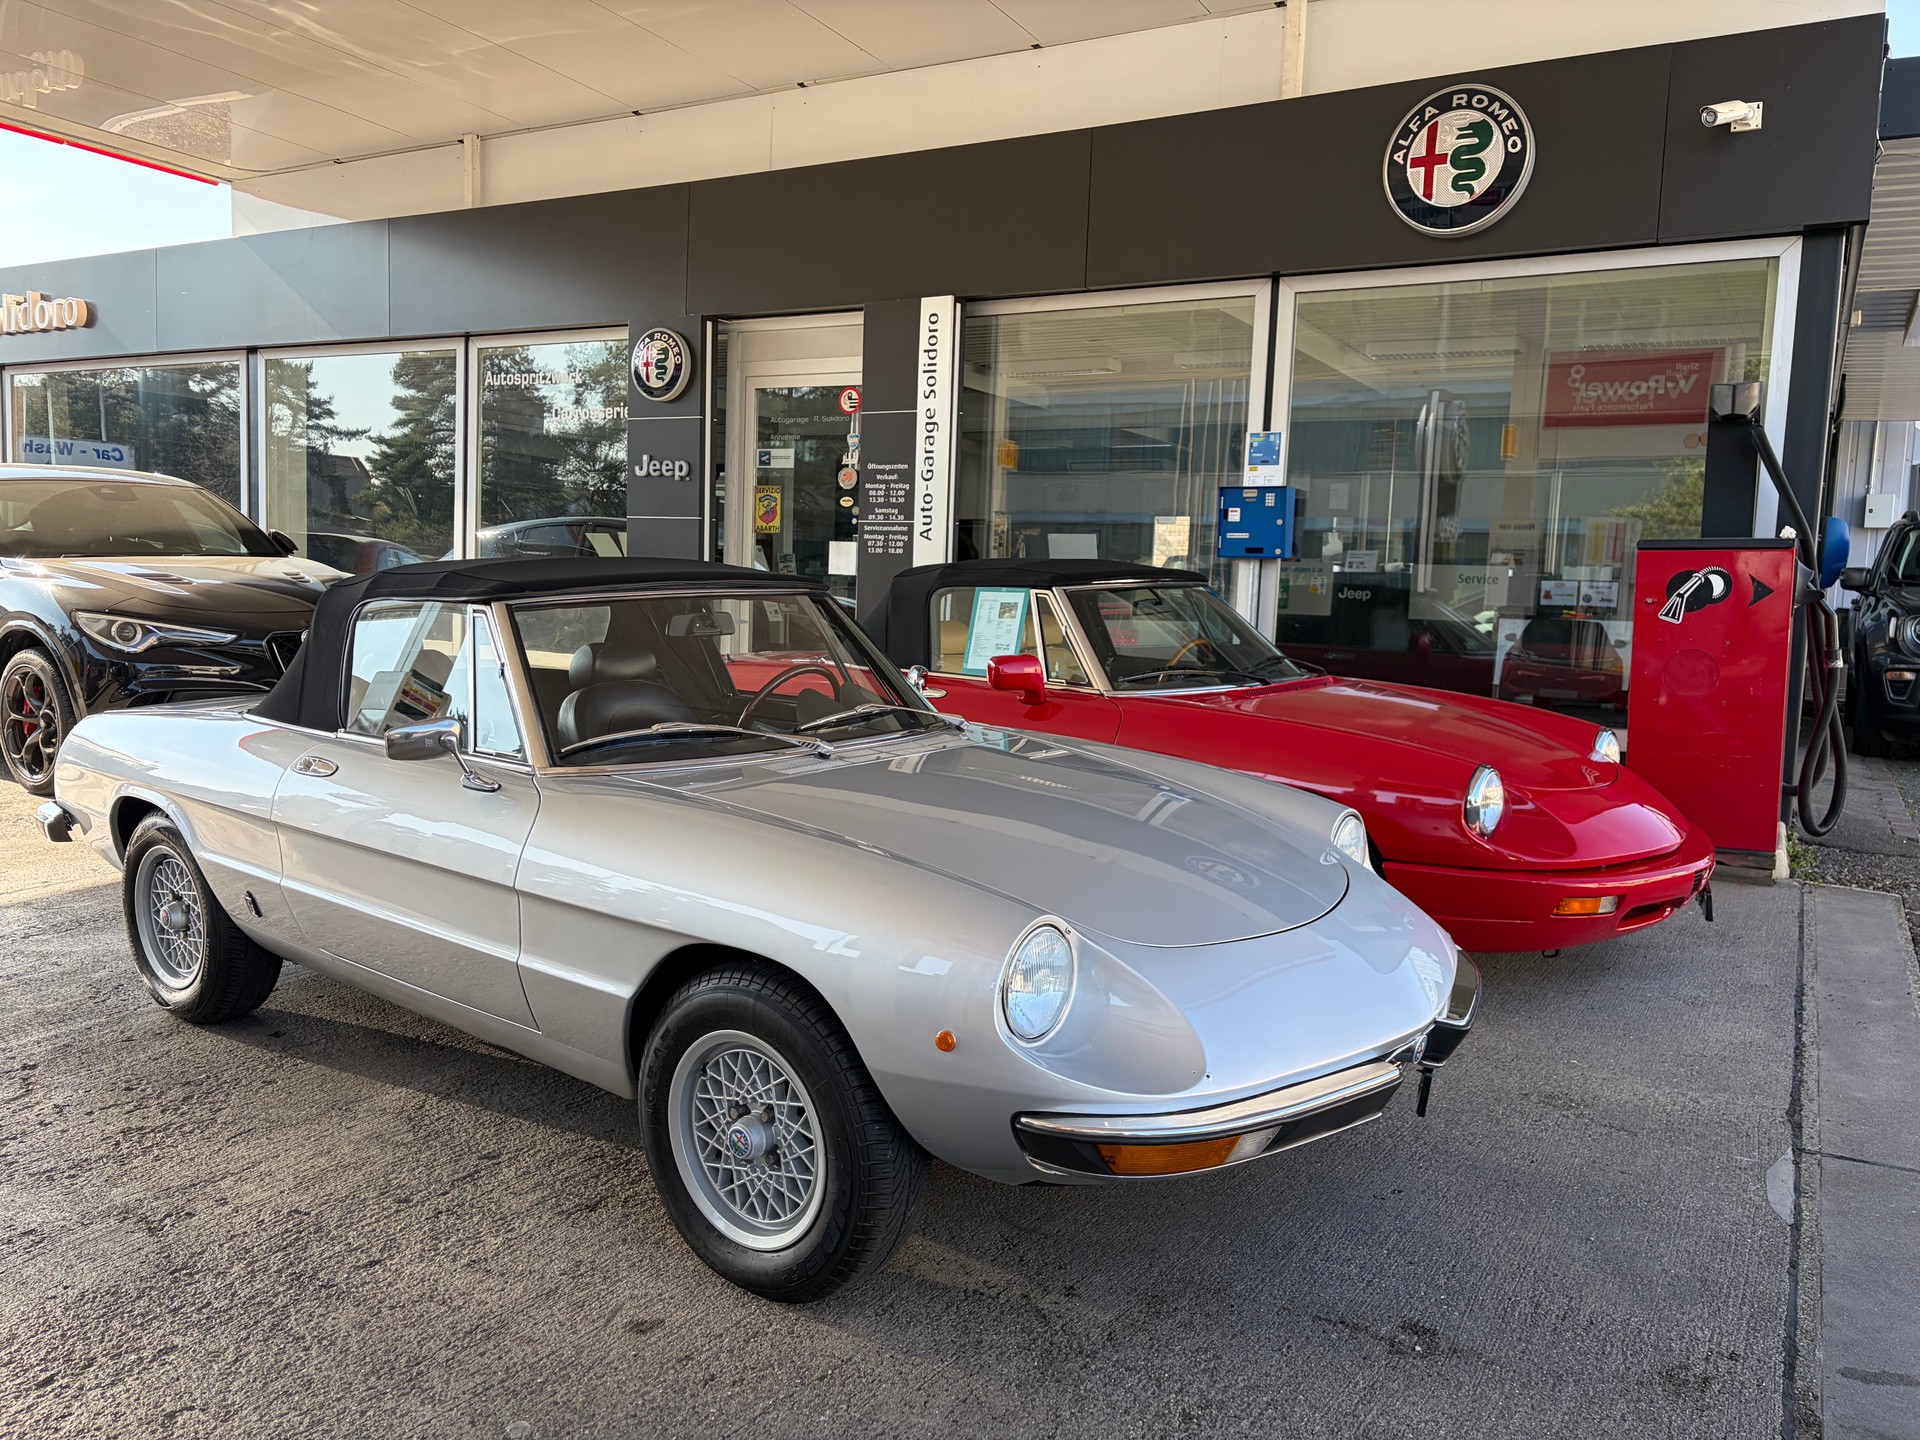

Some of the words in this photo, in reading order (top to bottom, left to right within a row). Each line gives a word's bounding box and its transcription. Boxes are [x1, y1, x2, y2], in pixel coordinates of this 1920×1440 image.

[1393, 105, 1440, 165] ALFA
[1451, 93, 1523, 154] ROMEO
[0, 290, 87, 334] lidoro
[633, 336, 651, 366] ALFA
[653, 332, 682, 364] ROMEO
[923, 311, 940, 400] Solidoro
[484, 369, 583, 389] Autospritzwerk
[821, 413, 850, 422] Solidoro
[634, 454, 689, 481] Jeep
[867, 462, 909, 471] Öffnungszeiten
[919, 408, 939, 541] Auto-Garage
[756, 487, 781, 495] SERVIZIO
[890, 482, 910, 491] Freitag
[889, 533, 909, 542] Freitag
[1458, 573, 1500, 586] Service
[1338, 587, 1372, 602] Jeep
